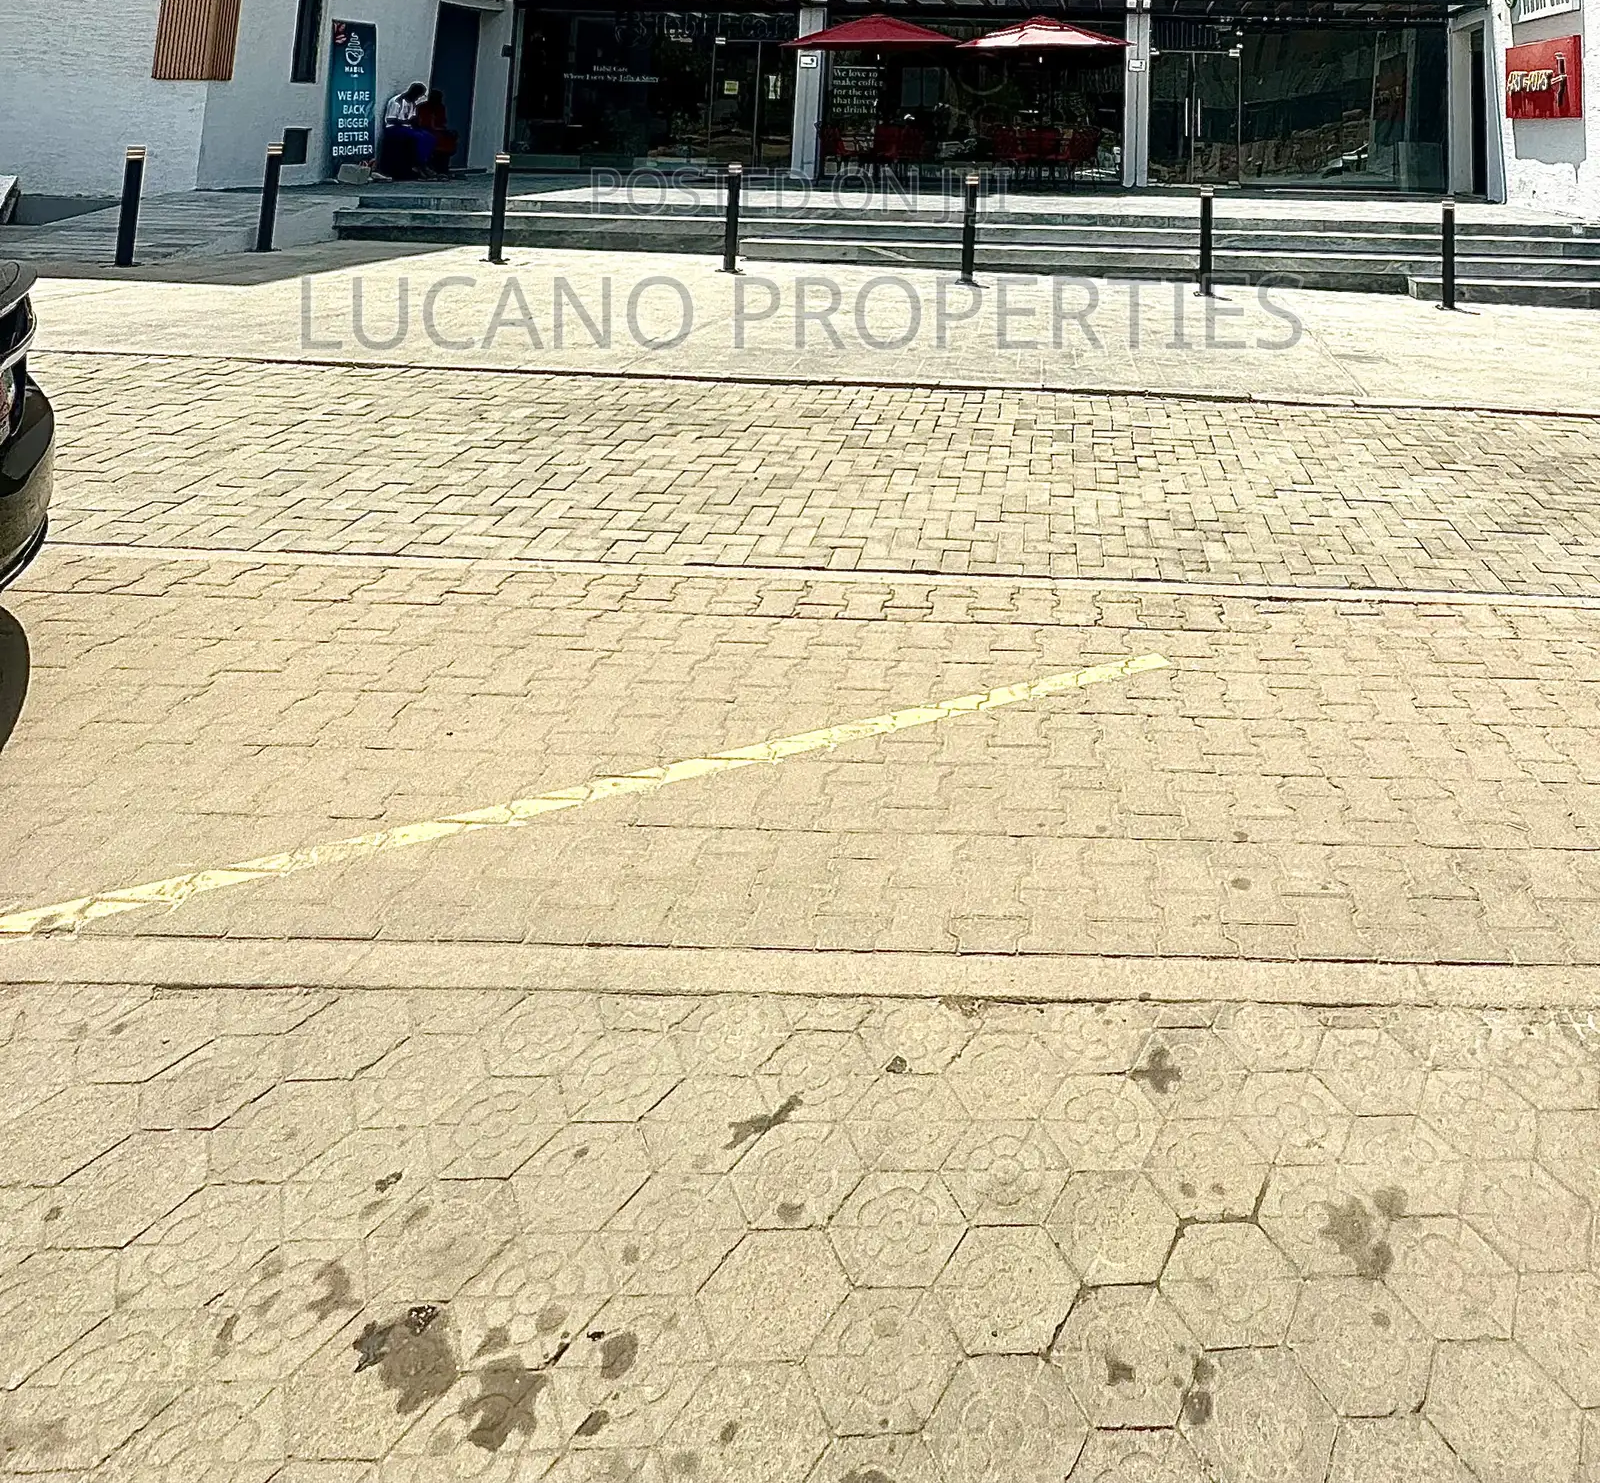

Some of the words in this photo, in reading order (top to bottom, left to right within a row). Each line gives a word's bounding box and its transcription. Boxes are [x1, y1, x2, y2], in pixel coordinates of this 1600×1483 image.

[834, 68, 847, 77] We
[848, 69, 867, 77] love
[833, 78, 857, 86] make
[337, 91, 352, 101] WE
[353, 91, 370, 101] ARE
[849, 88, 862, 96] the
[343, 105, 365, 115] BACK
[844, 106, 868, 114] drink
[338, 118, 369, 128] BIGGER
[337, 132, 369, 142] BETTER
[332, 145, 373, 156] BRIGHTER
